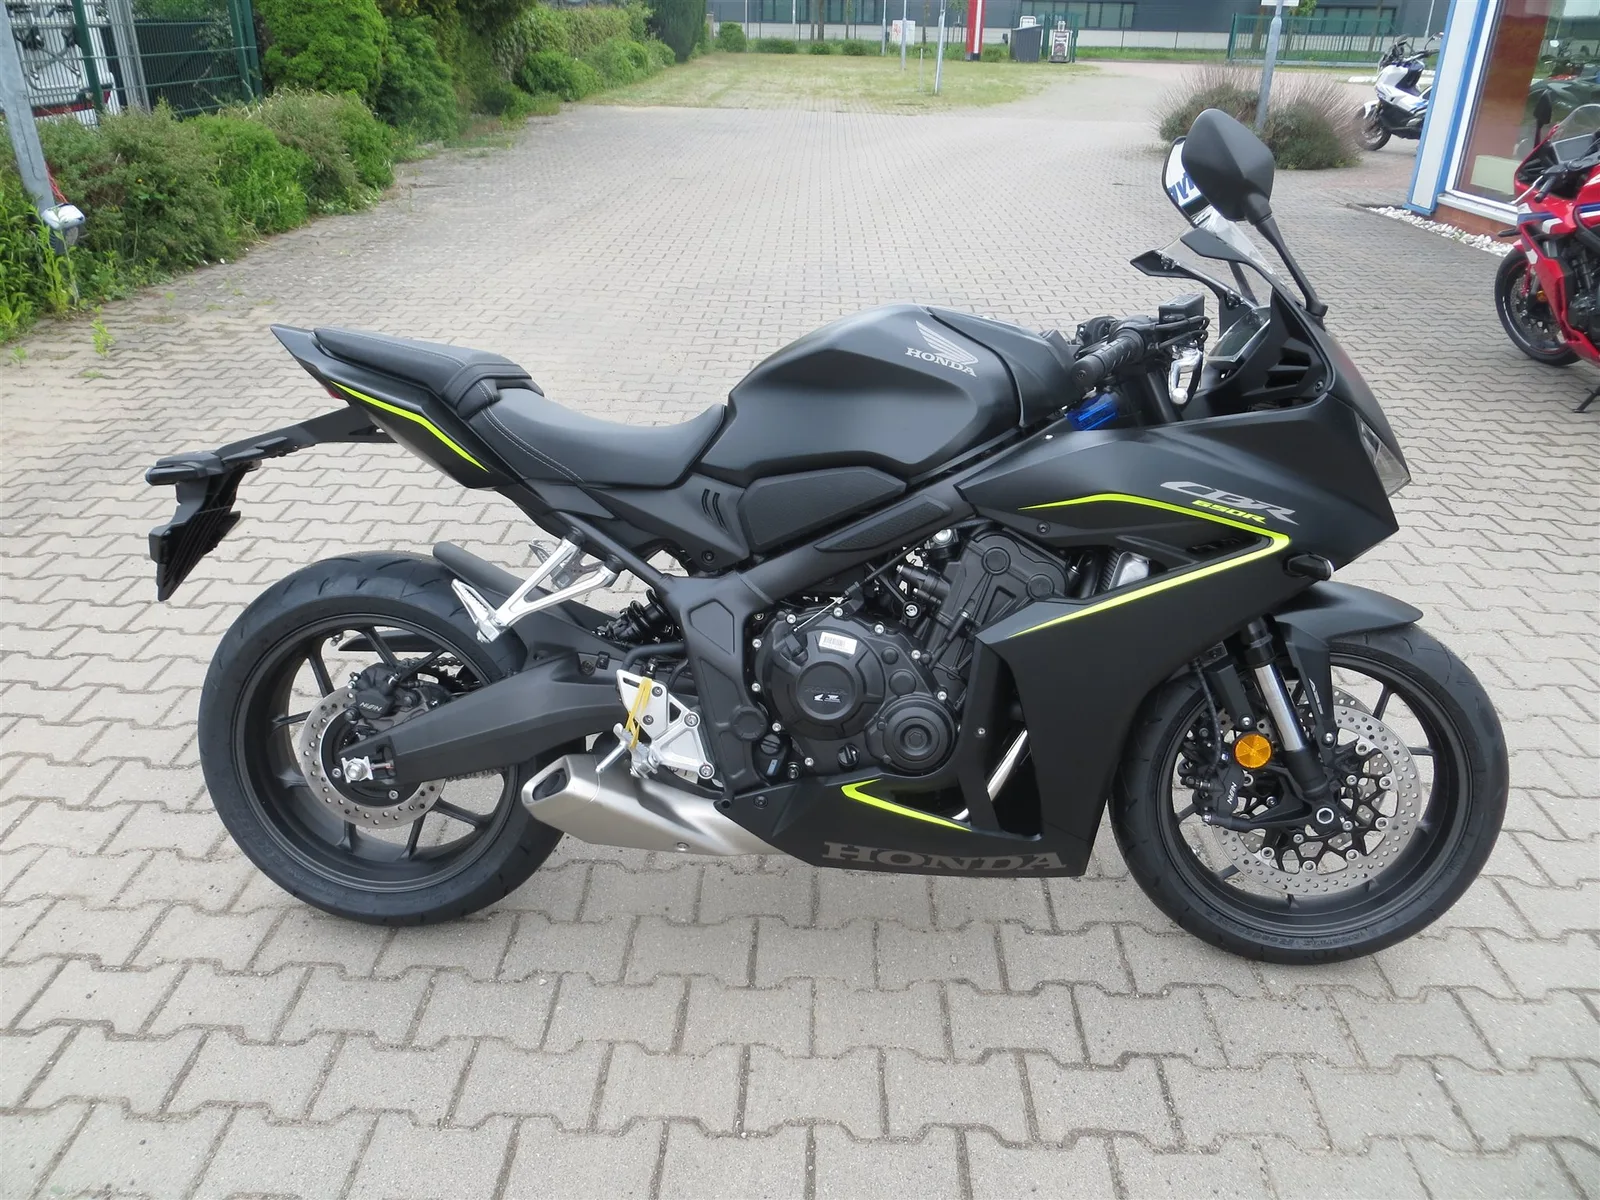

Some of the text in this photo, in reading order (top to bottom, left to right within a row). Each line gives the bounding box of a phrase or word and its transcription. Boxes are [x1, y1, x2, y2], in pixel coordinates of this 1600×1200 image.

[905, 347, 977, 378] HONDA
[1160, 481, 1299, 525] CBR
[1191, 499, 1266, 525] 650R
[822, 841, 1067, 871] HONDA
